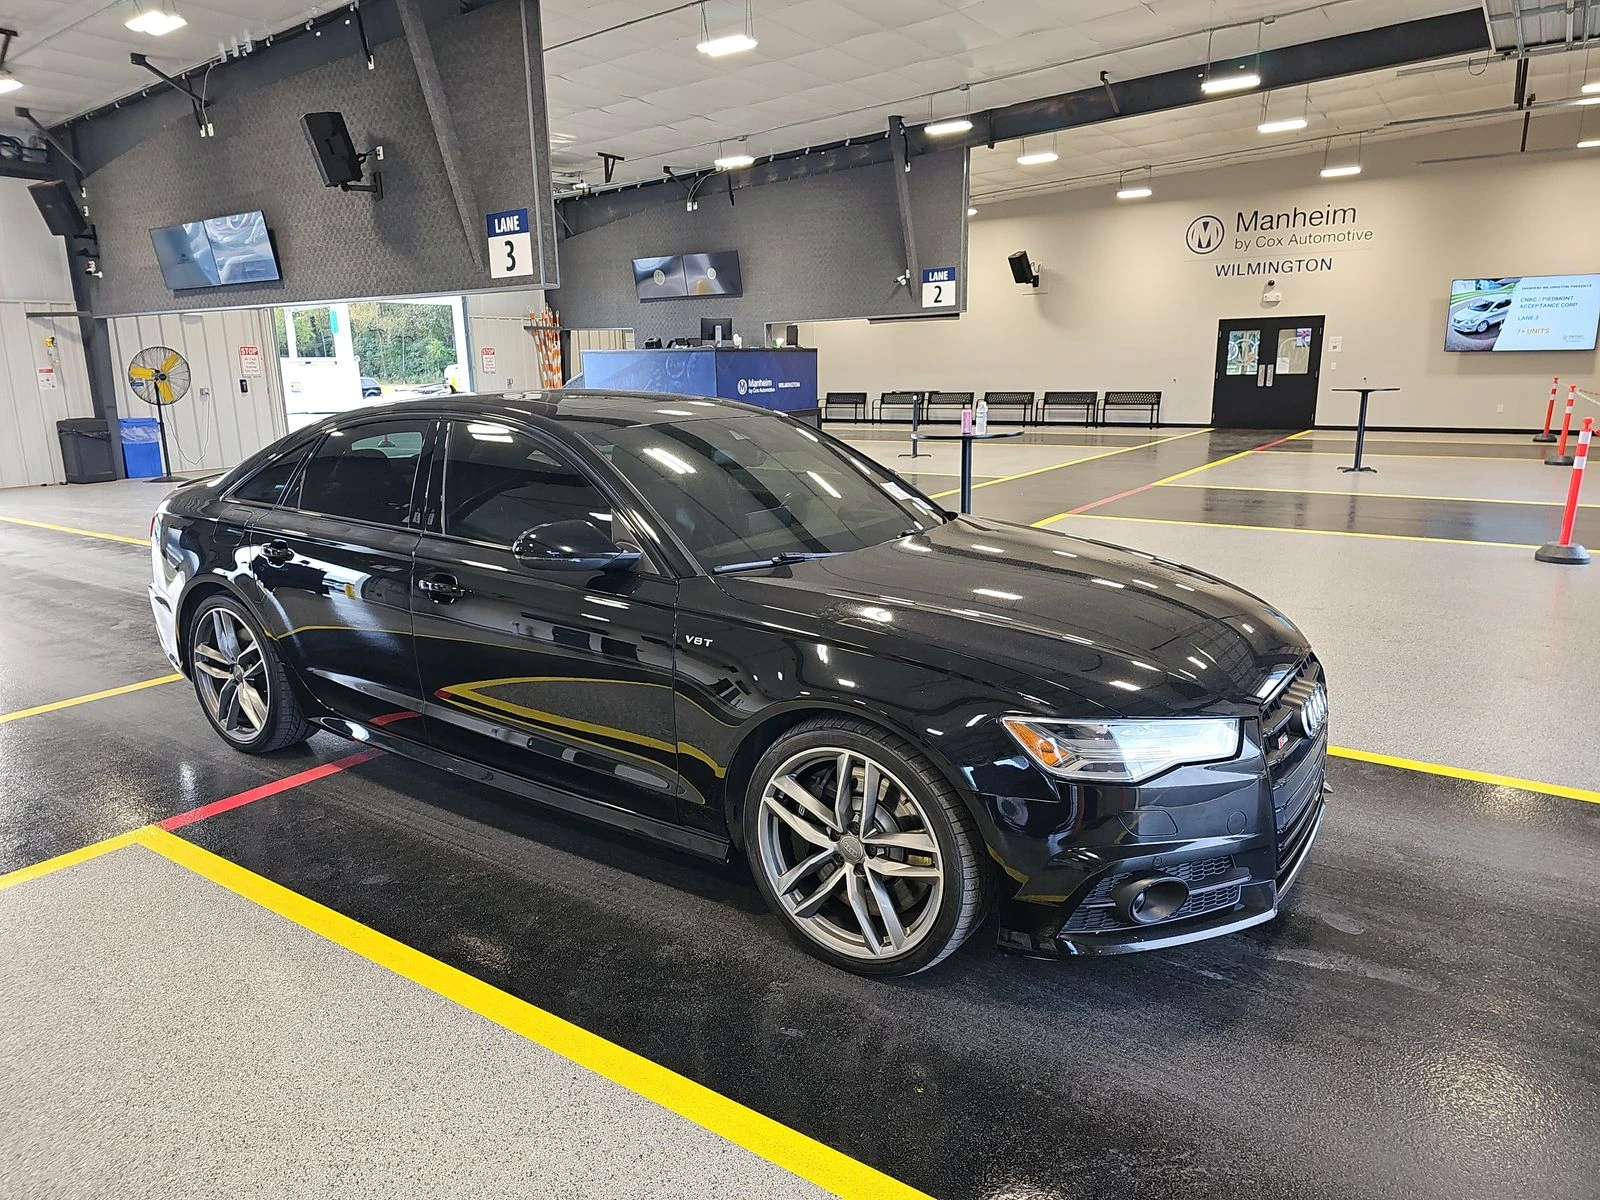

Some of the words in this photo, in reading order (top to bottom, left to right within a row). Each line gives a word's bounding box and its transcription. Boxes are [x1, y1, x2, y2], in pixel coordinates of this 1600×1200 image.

[494, 215, 520, 234] LANE
[1236, 204, 1357, 233] Manheim
[1234, 238, 1251, 252] by
[1255, 235, 1284, 249] Cox
[1287, 229, 1374, 246] Automotive
[504, 240, 516, 272] 3
[928, 270, 949, 282] LANE
[1215, 257, 1333, 277] WILMINGTON
[933, 285, 943, 304] 2
[241, 347, 257, 355] STOP
[748, 378, 772, 387] Manheim
[685, 634, 714, 647] V8T
